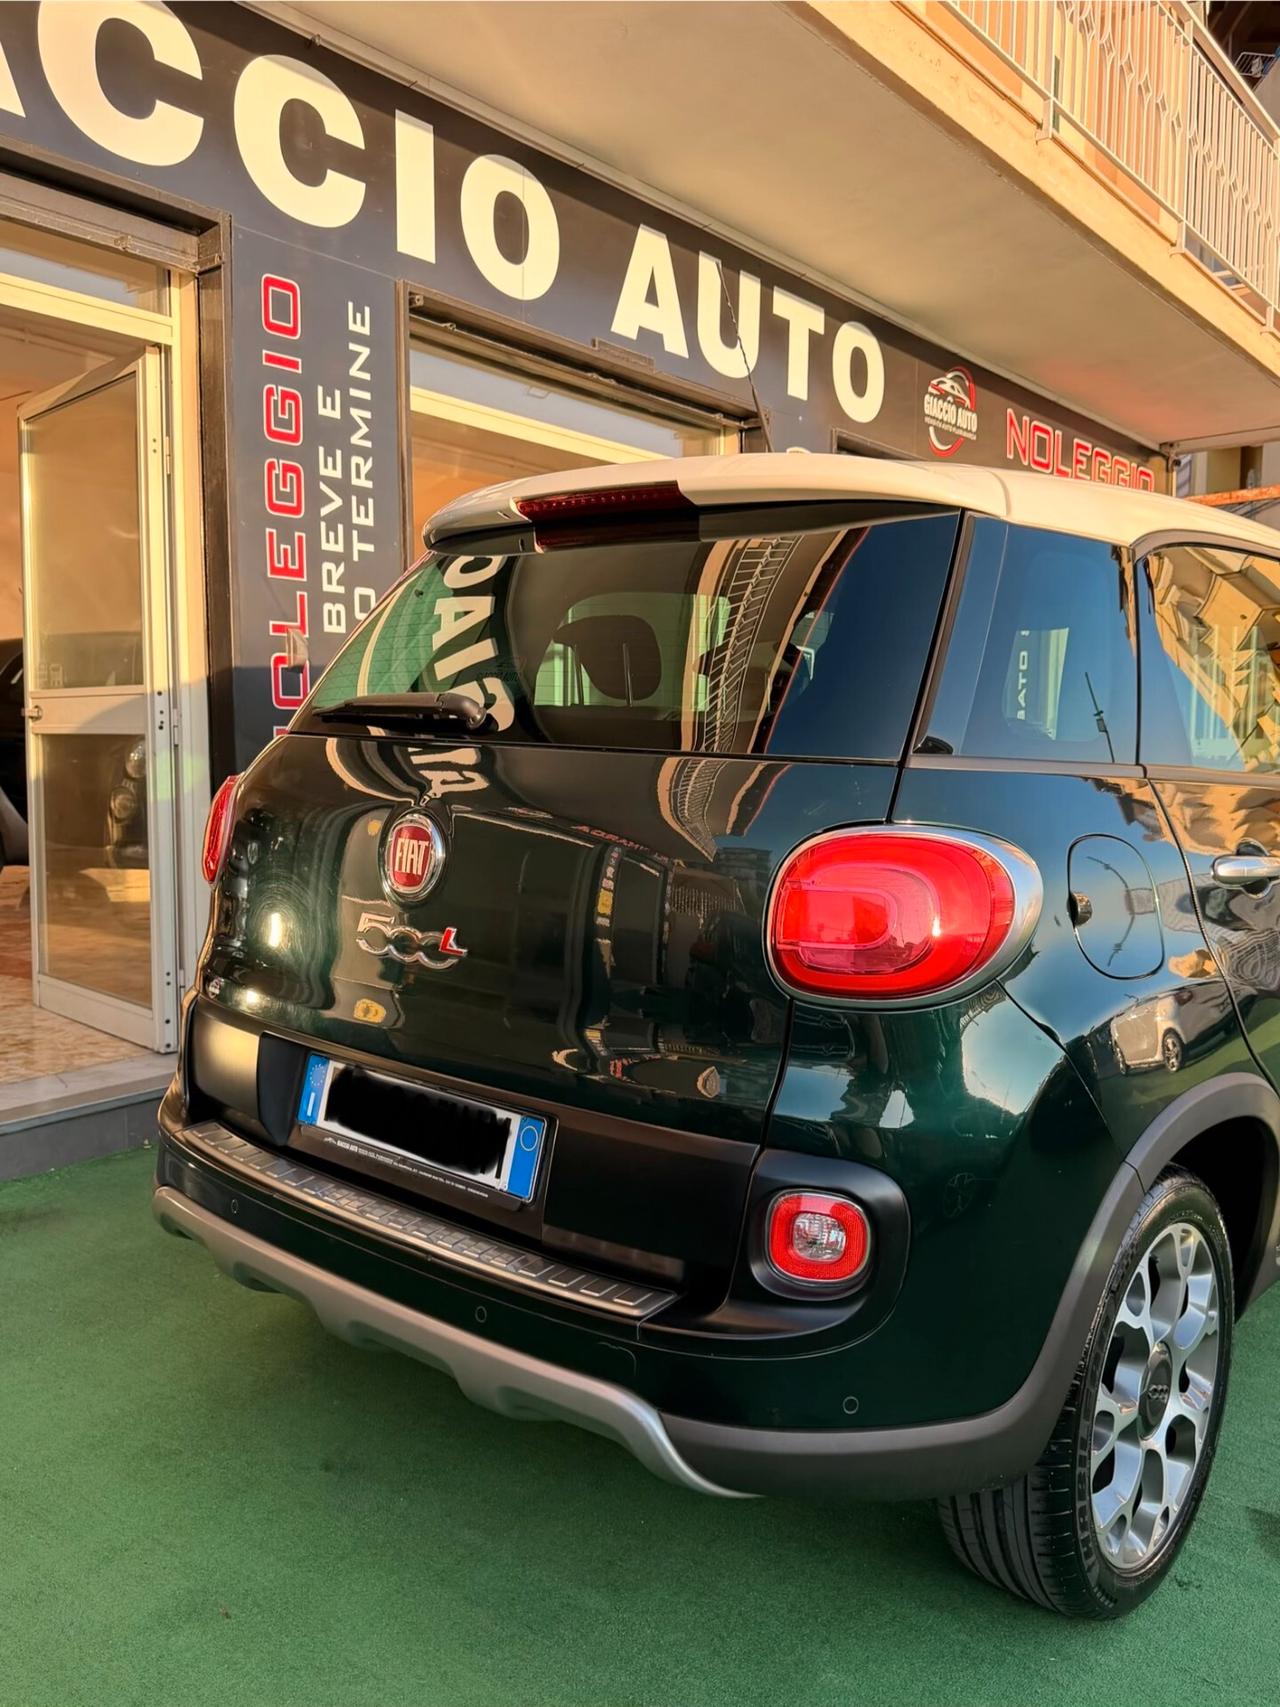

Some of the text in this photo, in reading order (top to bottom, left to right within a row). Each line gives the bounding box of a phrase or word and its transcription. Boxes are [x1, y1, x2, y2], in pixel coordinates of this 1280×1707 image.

[0, 1, 885, 424] CCIO AUTO
[347, 301, 375, 562] TERMINE
[957, 407, 978, 433] AUTO
[1006, 408, 1155, 493] NOLEGGIO
[261, 273, 310, 738] OLEGGIO
[317, 384, 346, 634] BREVE E
[394, 838, 429, 876] FIAT
[355, 912, 468, 970] 500L
